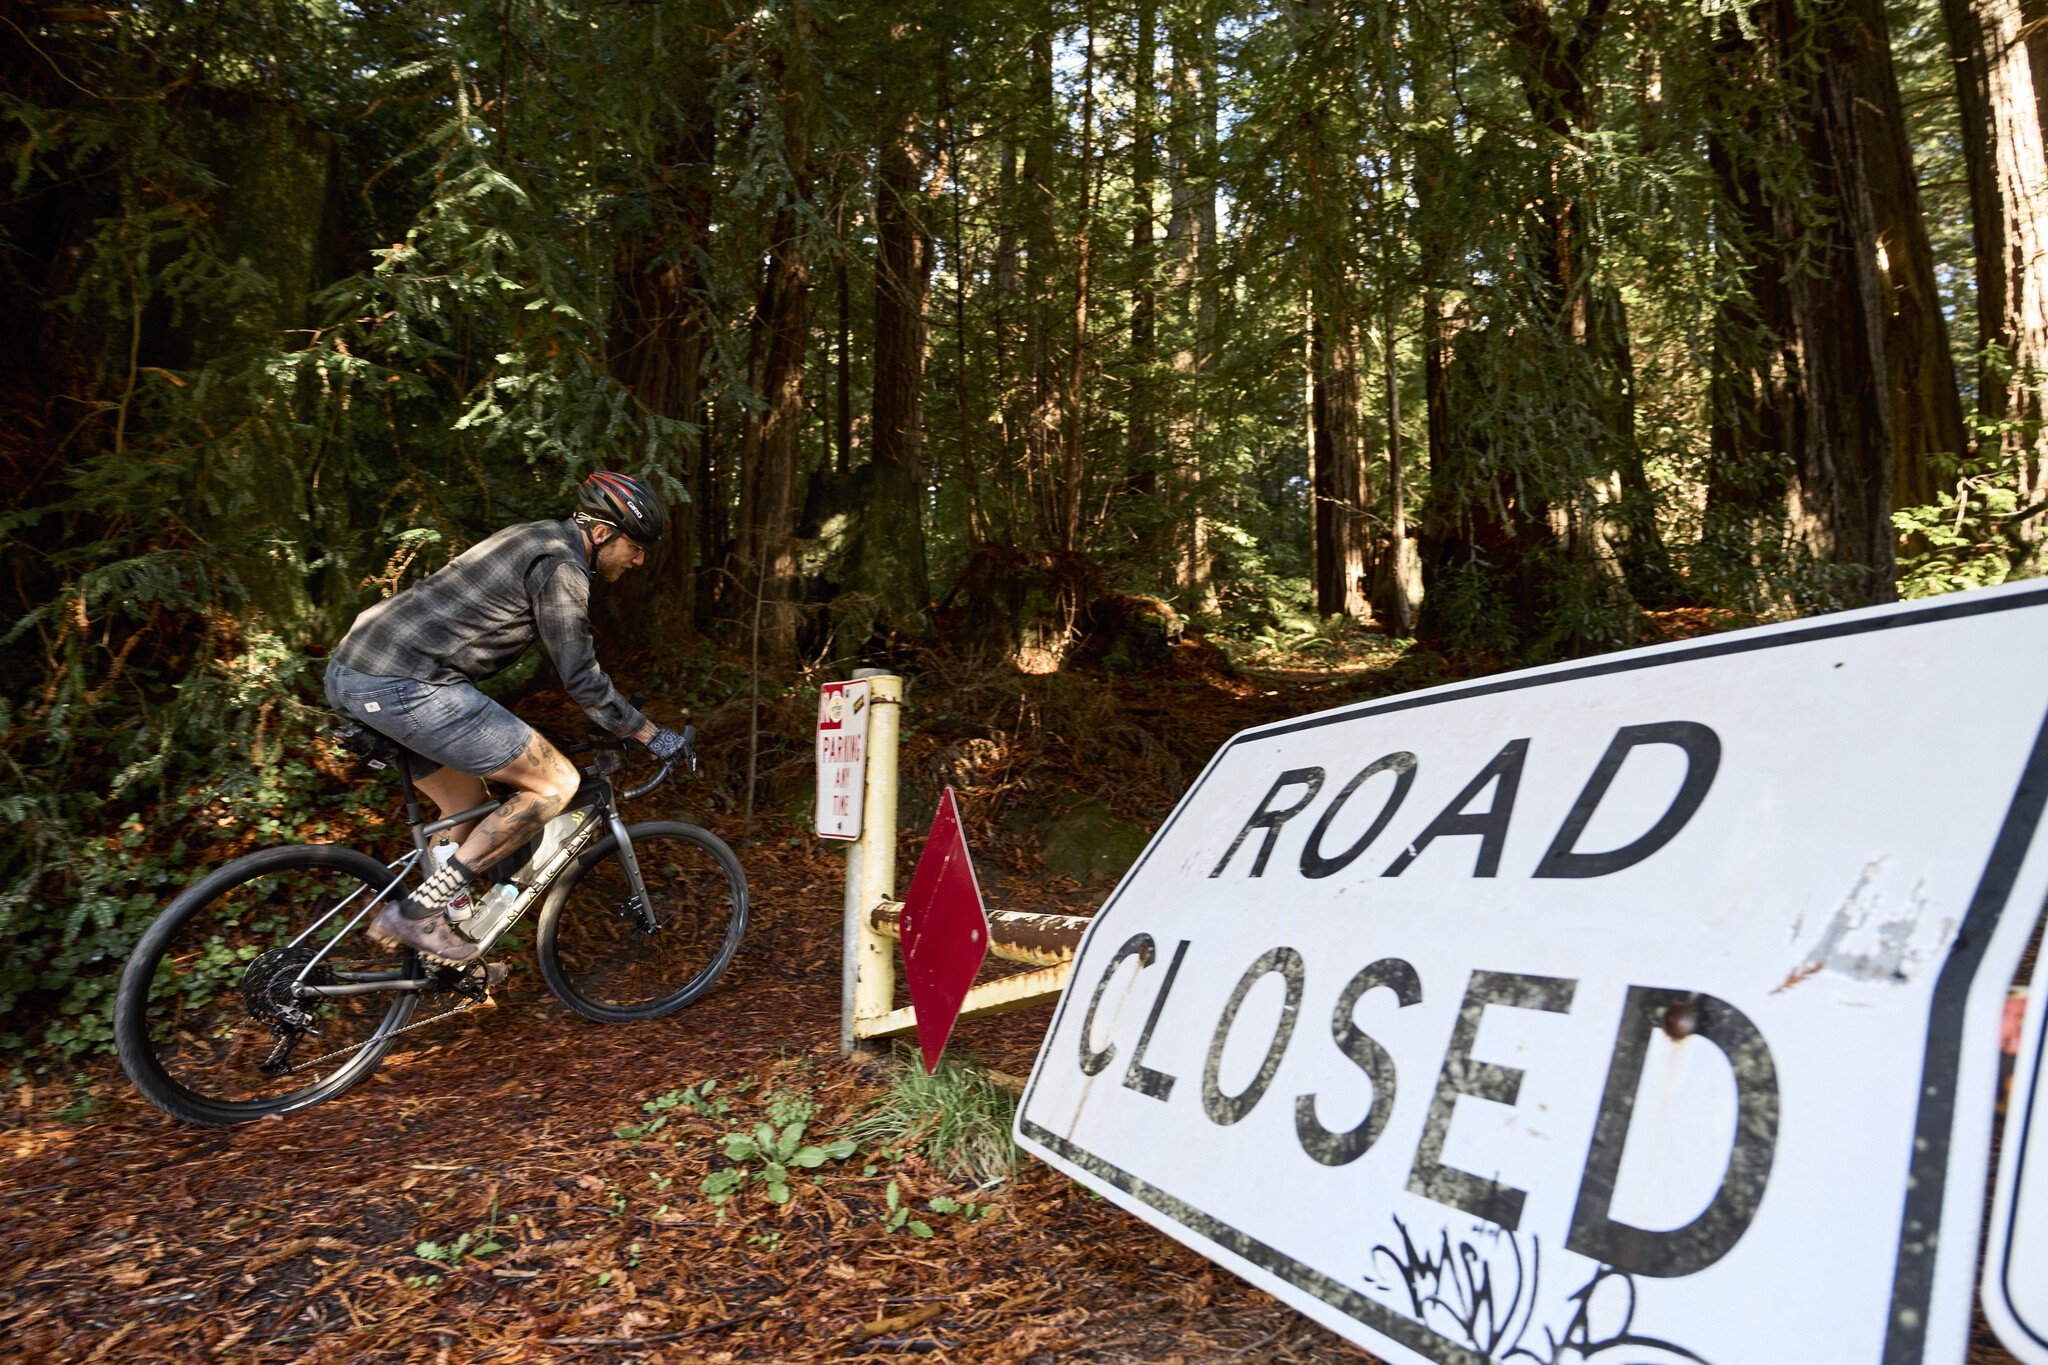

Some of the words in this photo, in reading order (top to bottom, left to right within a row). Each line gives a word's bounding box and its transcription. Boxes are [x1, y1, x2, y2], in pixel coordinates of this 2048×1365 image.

[627, 501, 643, 519] GIRO
[823, 733, 861, 763] PARKING
[834, 767, 851, 789] ANY
[833, 795, 850, 817] TIME
[1209, 720, 1722, 880] ROAD
[1078, 932, 1781, 1279] CLOSED
